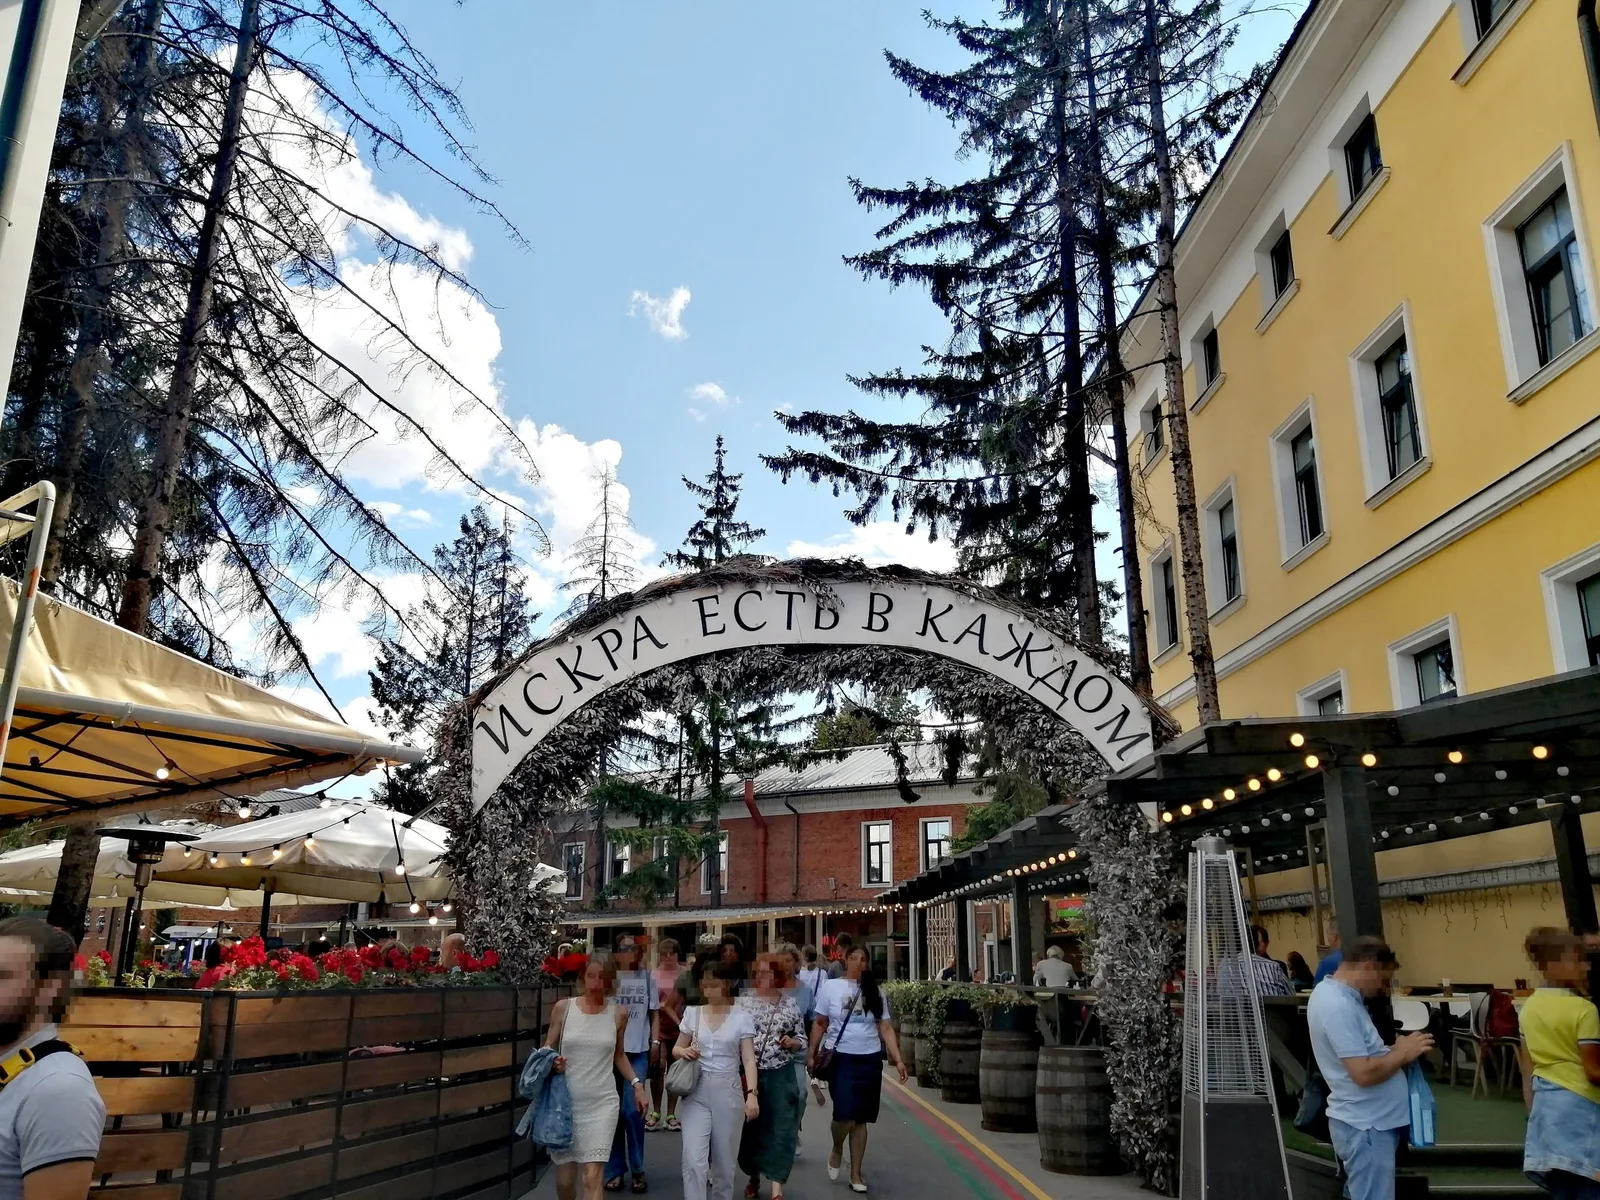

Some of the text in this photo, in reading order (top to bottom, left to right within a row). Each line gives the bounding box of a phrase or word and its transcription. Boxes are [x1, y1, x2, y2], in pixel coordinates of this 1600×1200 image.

[475, 590, 1150, 762] ИСКРА ЕСТЬ В КАЖДОМ
